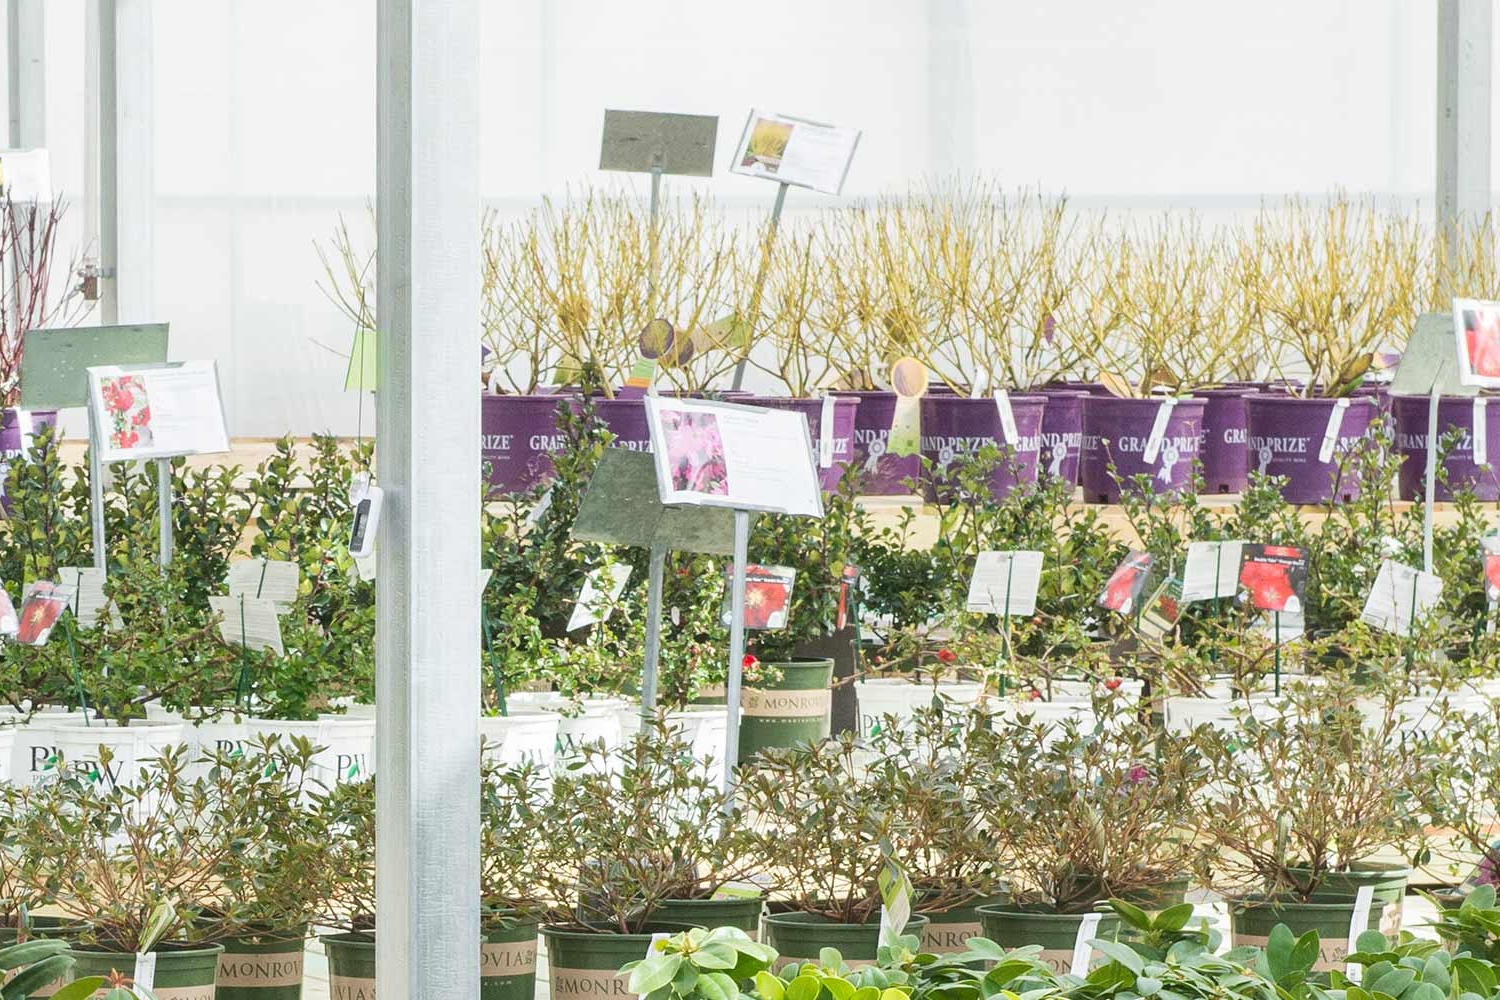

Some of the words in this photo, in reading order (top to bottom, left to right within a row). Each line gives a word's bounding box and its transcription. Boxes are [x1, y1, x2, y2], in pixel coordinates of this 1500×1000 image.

[481, 434, 510, 450] RIZE
[529, 435, 569, 450] GRAN
[1118, 436, 1170, 452] GRAD
[1223, 428, 1247, 444] GRA
[1266, 436, 1308, 453] PRIZE
